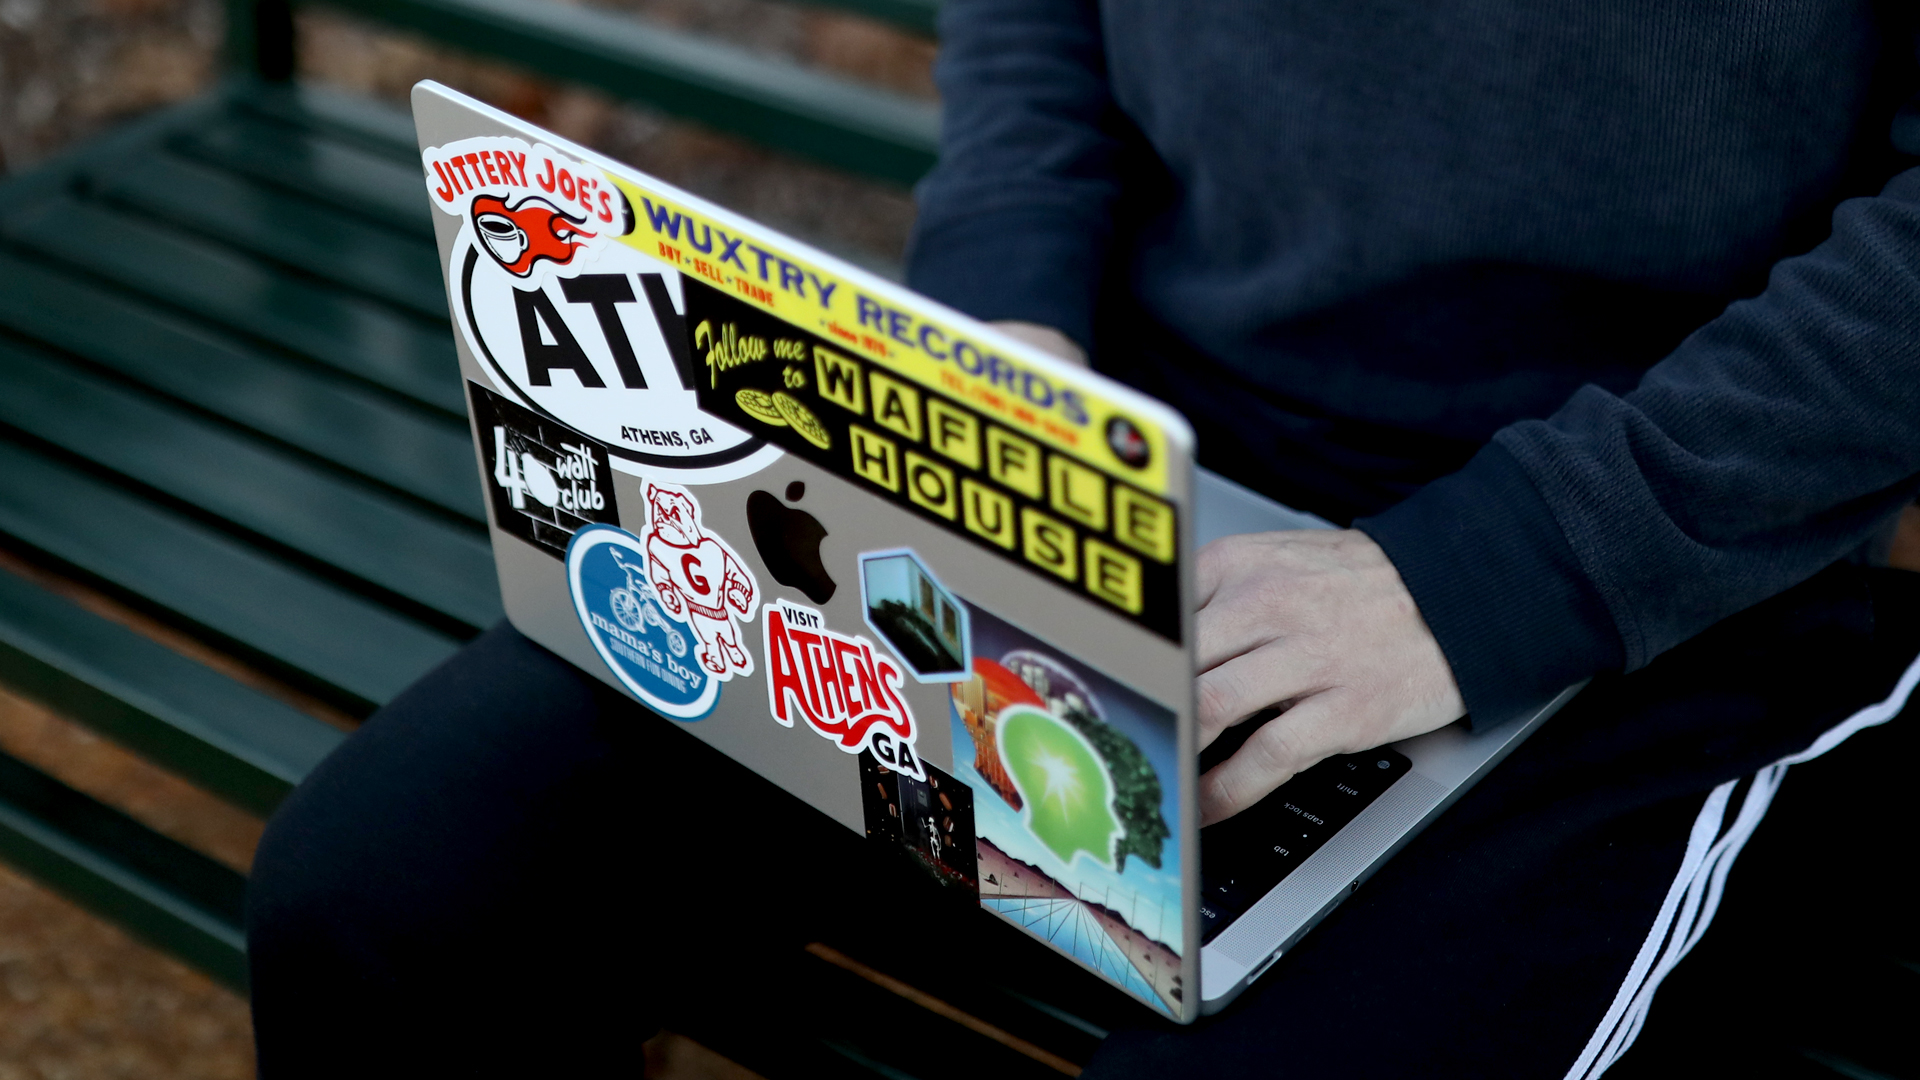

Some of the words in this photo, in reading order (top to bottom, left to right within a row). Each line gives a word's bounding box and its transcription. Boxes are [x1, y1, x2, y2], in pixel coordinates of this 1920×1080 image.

[432, 149, 529, 203] JITTERY
[536, 157, 613, 223] JOE'S
[658, 241, 682, 265] BUY
[693, 258, 724, 285] SELL
[735, 276, 775, 308] TRADE
[641, 196, 837, 310] WUXTRY
[855, 292, 1089, 427] RECORDS
[694, 319, 768, 390] Follow
[773, 337, 805, 362] me
[782, 365, 805, 389] to
[621, 425, 691, 450] ATHENS,
[690, 428, 714, 445] GA
[820, 353, 1161, 552] WAFFLE
[556, 442, 599, 481] watt
[561, 479, 605, 510] club
[856, 433, 1132, 607] HOUSE
[681, 553, 711, 595] G
[782, 606, 819, 629] VISIT
[590, 612, 663, 664] mama's
[665, 653, 702, 689] boy
[769, 610, 911, 747] ATHENS
[872, 732, 919, 775] GA
[1284, 802, 1302, 815] lock
[1336, 783, 1359, 796] shift
[1302, 812, 1324, 825] caps
[1273, 845, 1290, 857] tab
[1199, 907, 1216, 919] esc
